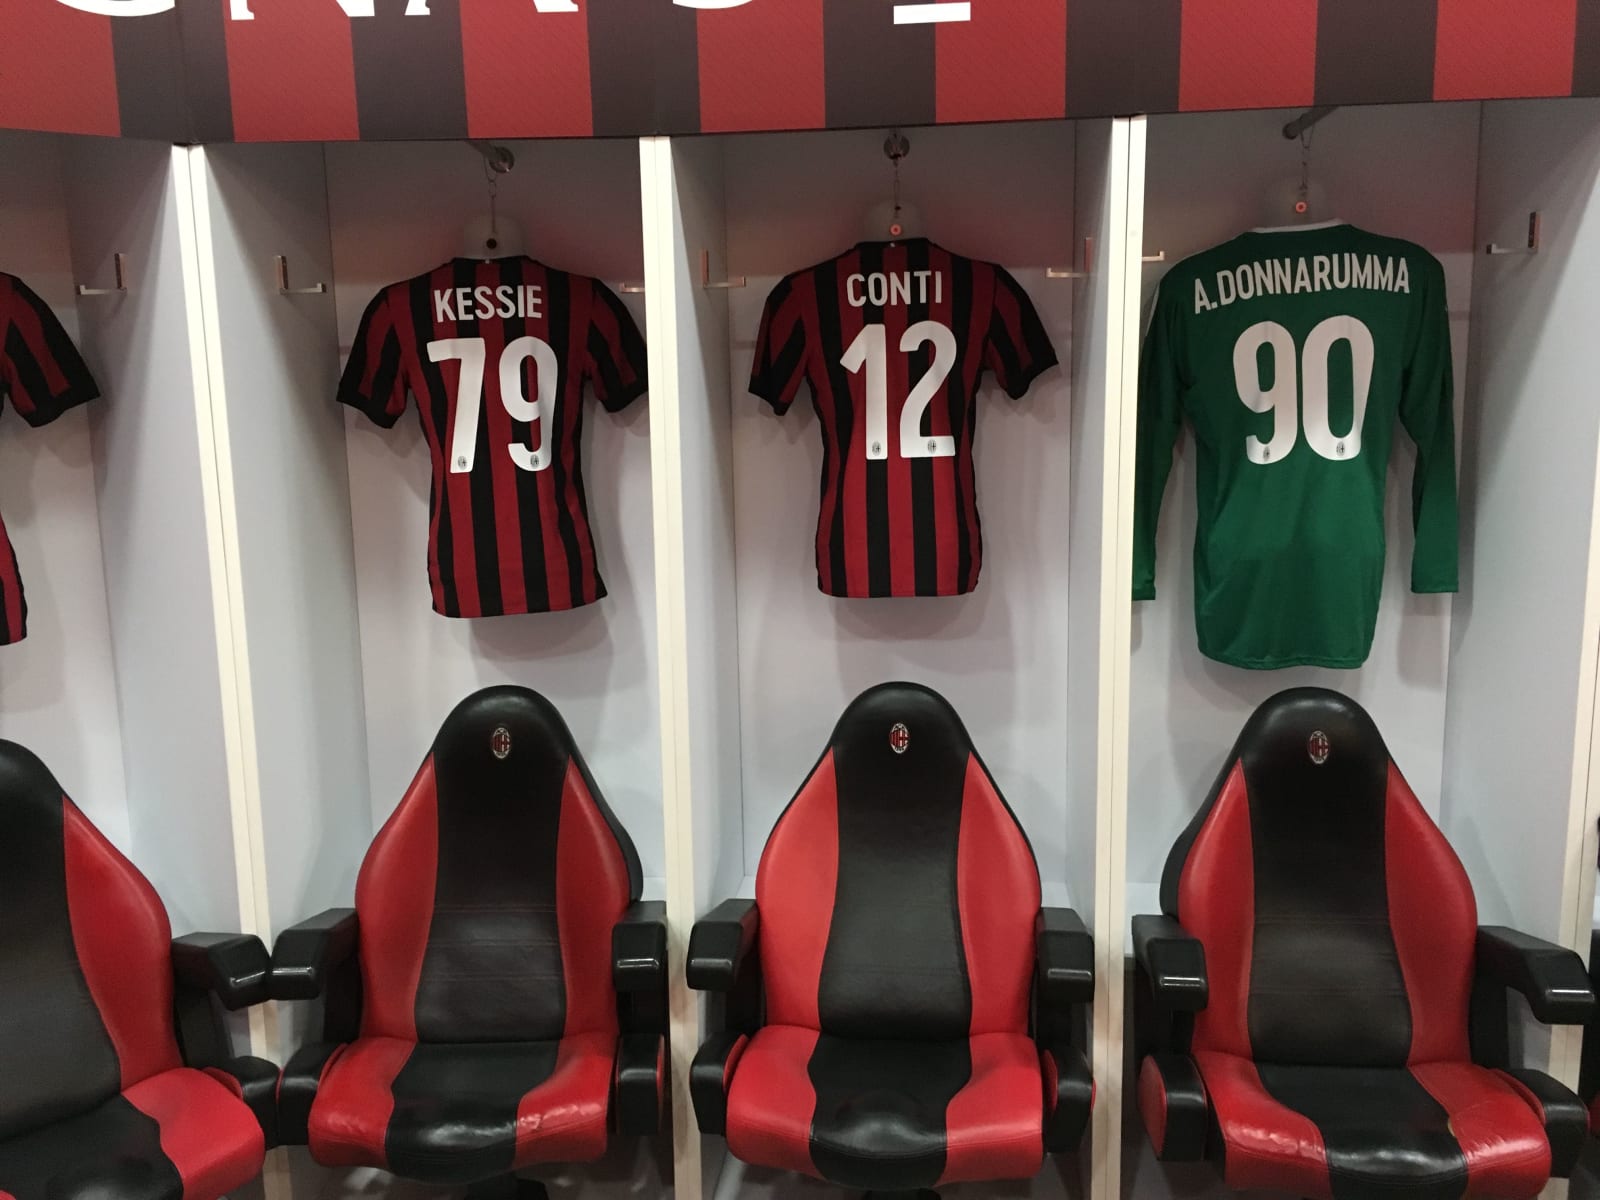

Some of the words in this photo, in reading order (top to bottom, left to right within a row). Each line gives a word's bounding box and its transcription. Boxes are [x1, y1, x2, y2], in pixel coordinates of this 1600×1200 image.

[433, 285, 543, 323] KESSIE
[846, 270, 943, 307] CONTI
[1194, 253, 1411, 315] A.DONNARUMMA
[426, 336, 559, 474] 79
[839, 320, 958, 460] 12
[1232, 314, 1375, 465] 90
